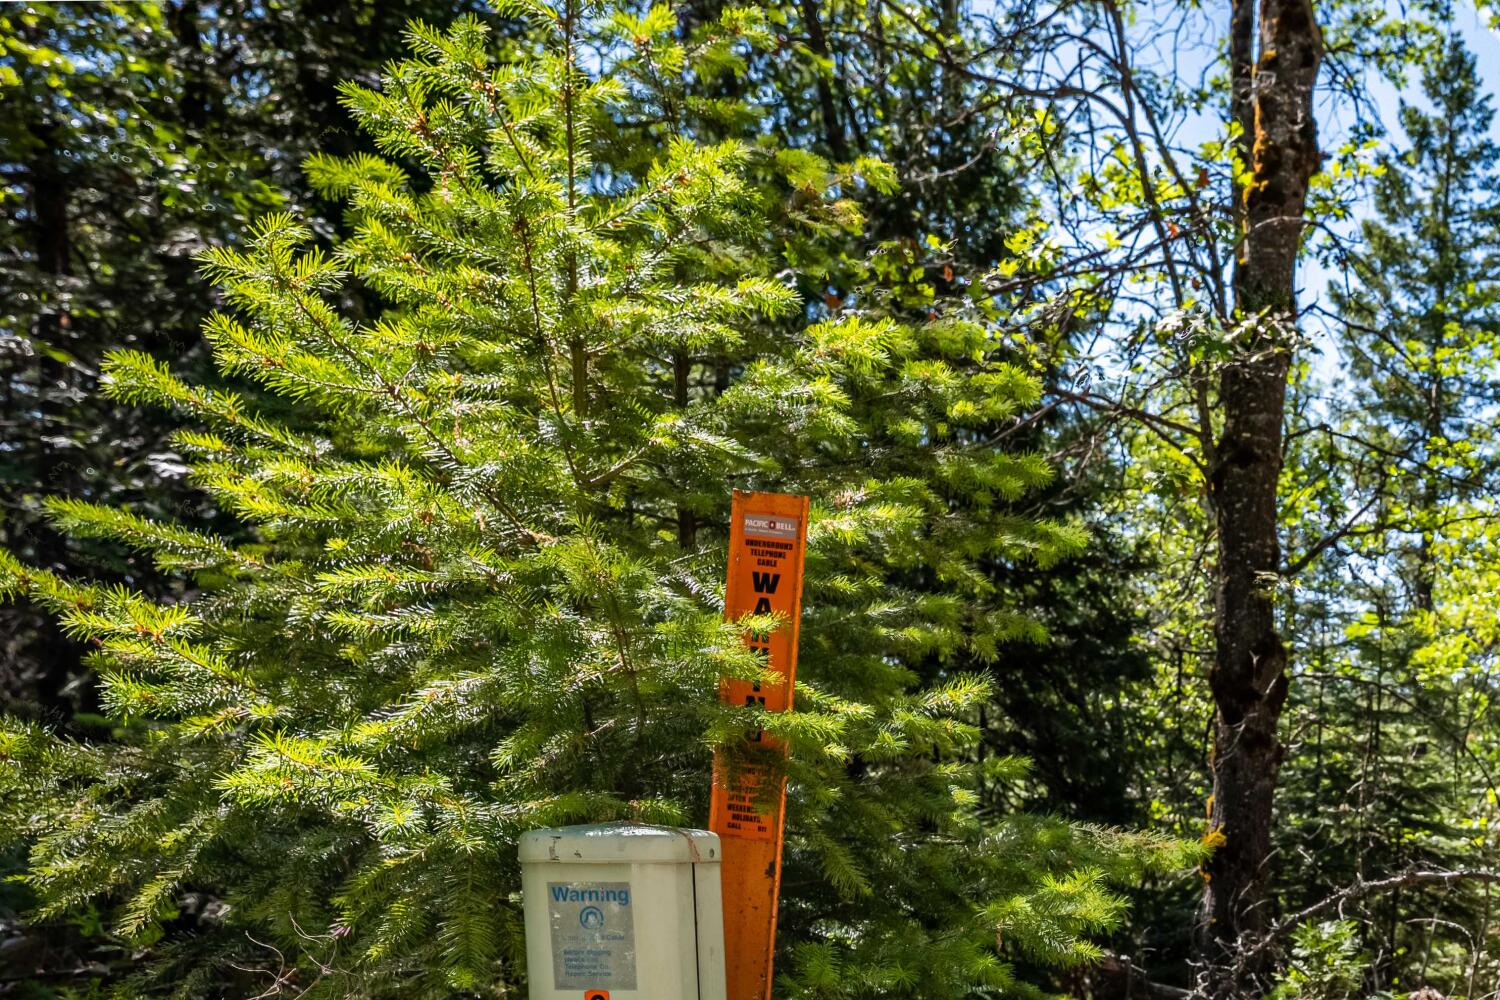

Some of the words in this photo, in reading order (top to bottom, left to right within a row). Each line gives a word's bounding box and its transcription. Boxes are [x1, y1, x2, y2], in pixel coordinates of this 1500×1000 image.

[745, 519, 768, 528] PACIFIC
[776, 522, 793, 530] BELL
[745, 539, 793, 550] UNDERGROUND
[751, 549, 786, 559] TELEPHONE
[757, 559, 777, 567] CABLE
[552, 886, 629, 906] Warning
